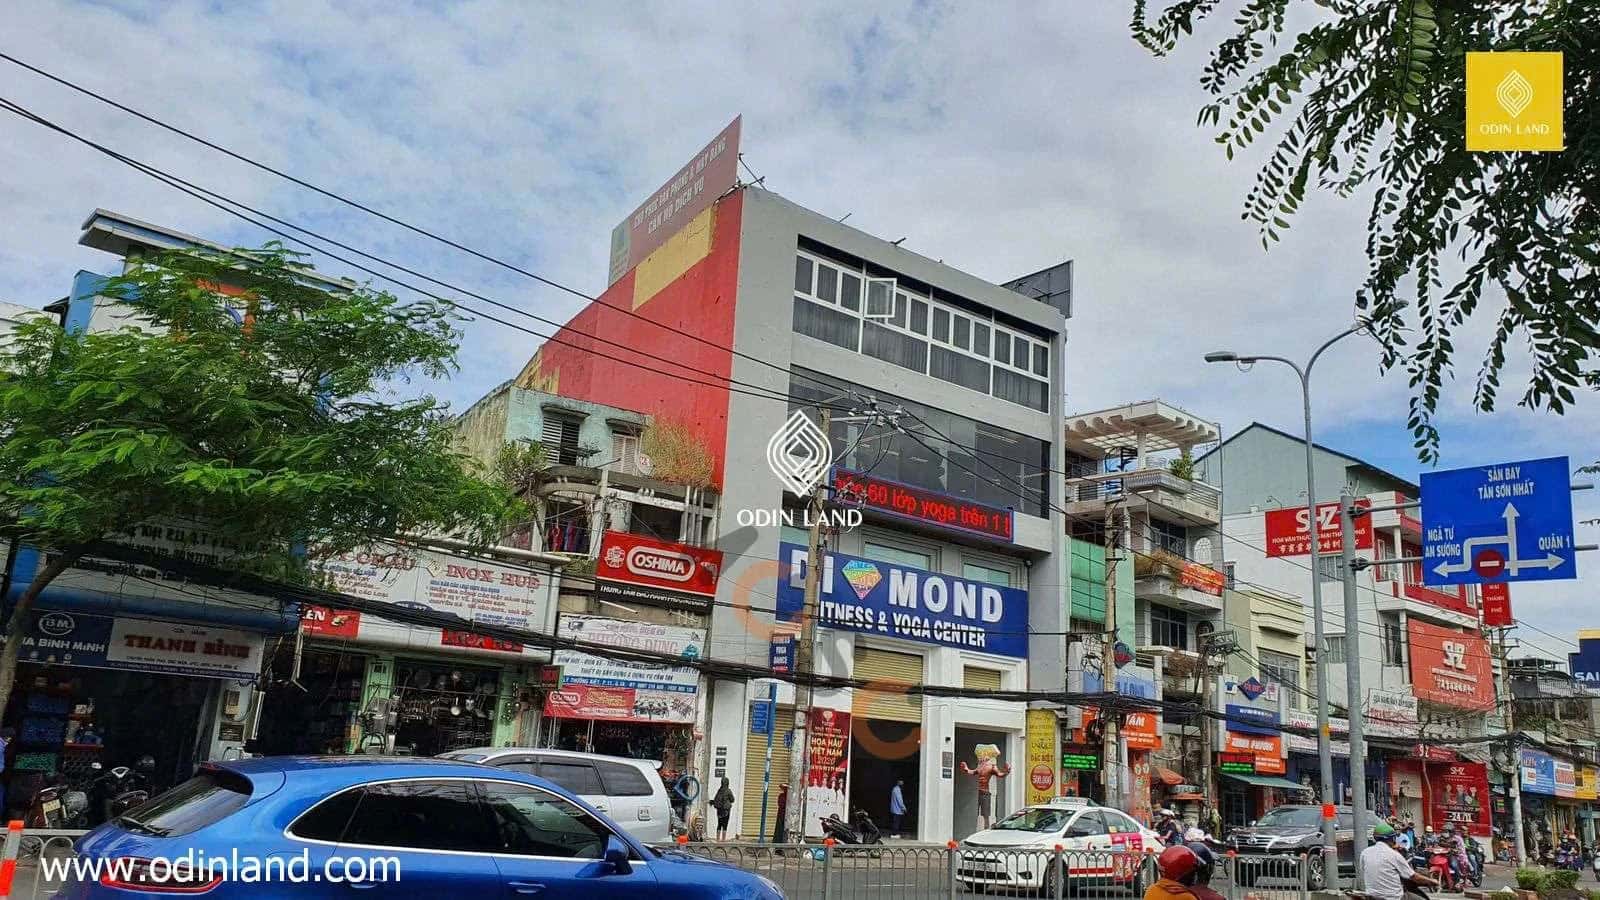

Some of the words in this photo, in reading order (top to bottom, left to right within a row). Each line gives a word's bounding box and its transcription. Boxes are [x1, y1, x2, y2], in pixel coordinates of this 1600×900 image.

[1488, 468, 1504, 482] SÂN
[1505, 466, 1521, 480] BAY
[1478, 485, 1494, 500] TÂN
[1495, 484, 1513, 498] SƠN
[1513, 478, 1534, 496] NHẤT
[868, 484, 888, 505] 60
[892, 488, 916, 514] lớp
[921, 500, 957, 523] yoga
[961, 506, 989, 528] trên
[1427, 527, 1443, 541] NGÃ
[1443, 525, 1455, 541] TƯ
[1538, 533, 1563, 552] QUẬN
[1566, 535, 1571, 548] 1
[1425, 546, 1436, 558] AN
[1436, 543, 1461, 557] SƯƠNG
[447, 564, 494, 583] INOX
[634, 554, 685, 574] OSHIMA
[889, 569, 1003, 623] MOND
[302, 609, 326, 622] EN
[819, 600, 873, 629] ITNESS
[878, 611, 888, 632] &
[892, 612, 931, 640] YOGA
[933, 620, 986, 648] CENTER
[809, 746, 826, 757] VIỆT
[827, 747, 843, 758] NAM
[811, 737, 827, 748] HOA
